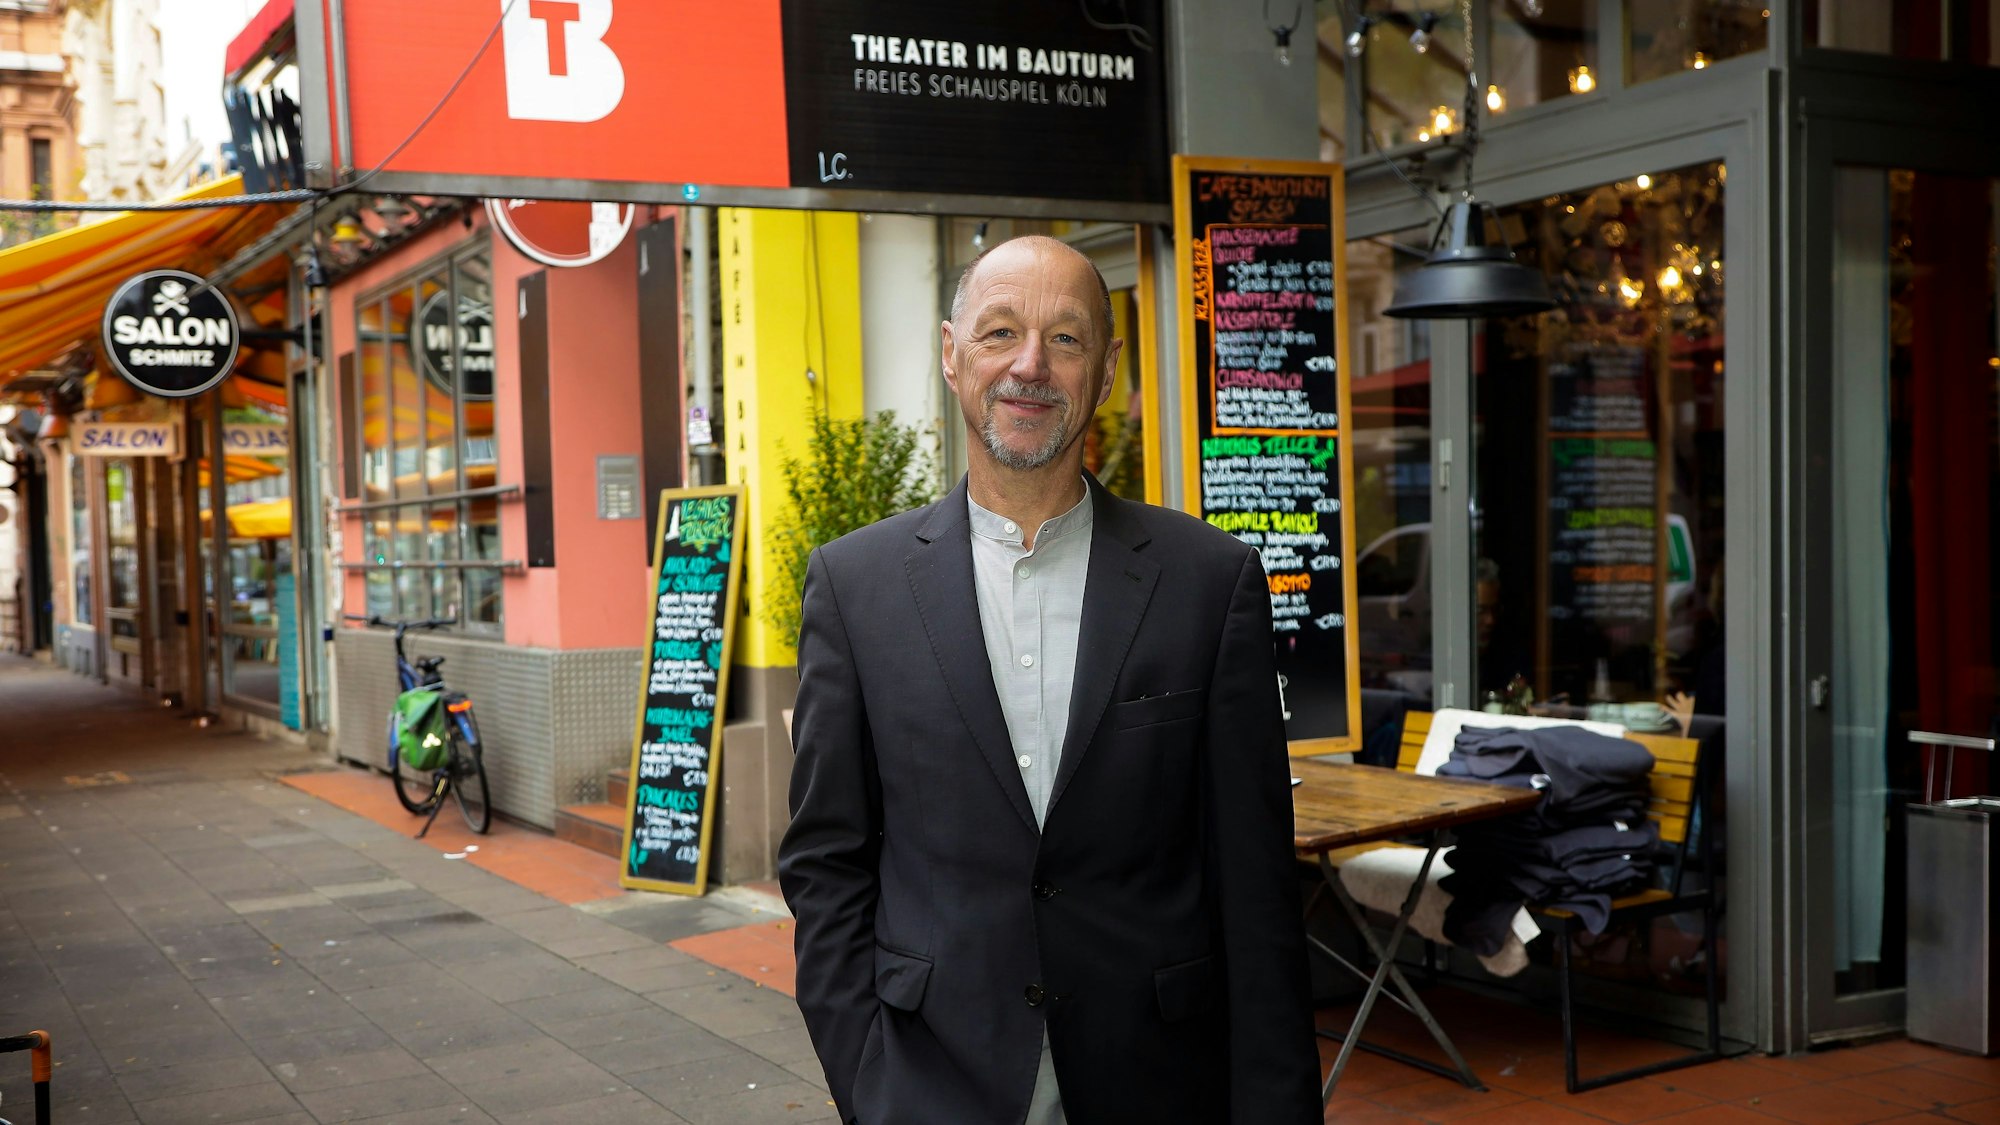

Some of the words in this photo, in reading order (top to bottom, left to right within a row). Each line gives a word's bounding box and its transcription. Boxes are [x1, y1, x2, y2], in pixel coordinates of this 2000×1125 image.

[851, 33, 968, 68] THEATER
[977, 43, 1008, 71] IM
[1017, 46, 1135, 80] BAUTURM
[854, 68, 922, 95] FREIES
[928, 73, 1049, 105] SCHAUSPIEL
[1056, 80, 1107, 107] KÖLN
[113, 315, 230, 346] SALON
[129, 348, 215, 367] SCHMITZ
[80, 428, 168, 449] SALON
